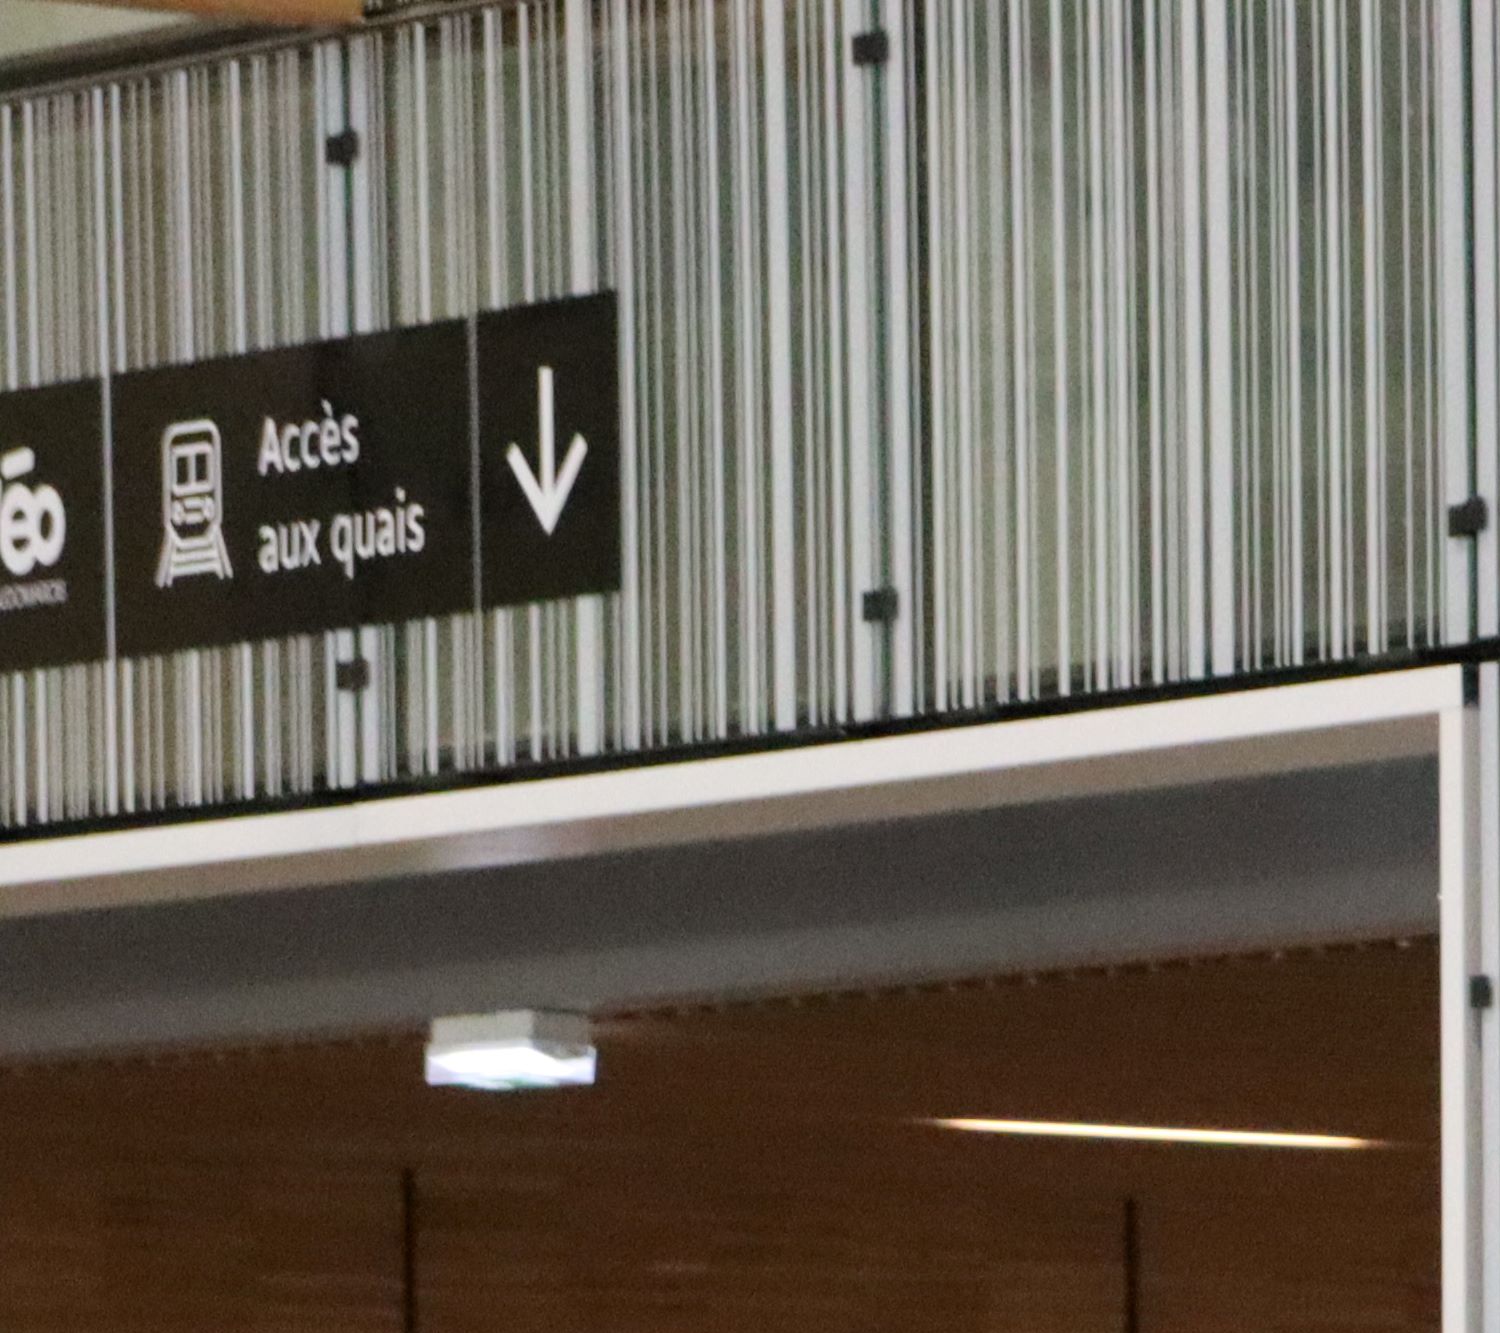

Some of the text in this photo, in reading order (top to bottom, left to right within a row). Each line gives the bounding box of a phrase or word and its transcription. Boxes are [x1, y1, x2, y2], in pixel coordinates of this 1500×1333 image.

[257, 398, 360, 477] Accès
[257, 486, 426, 580] aux quais
